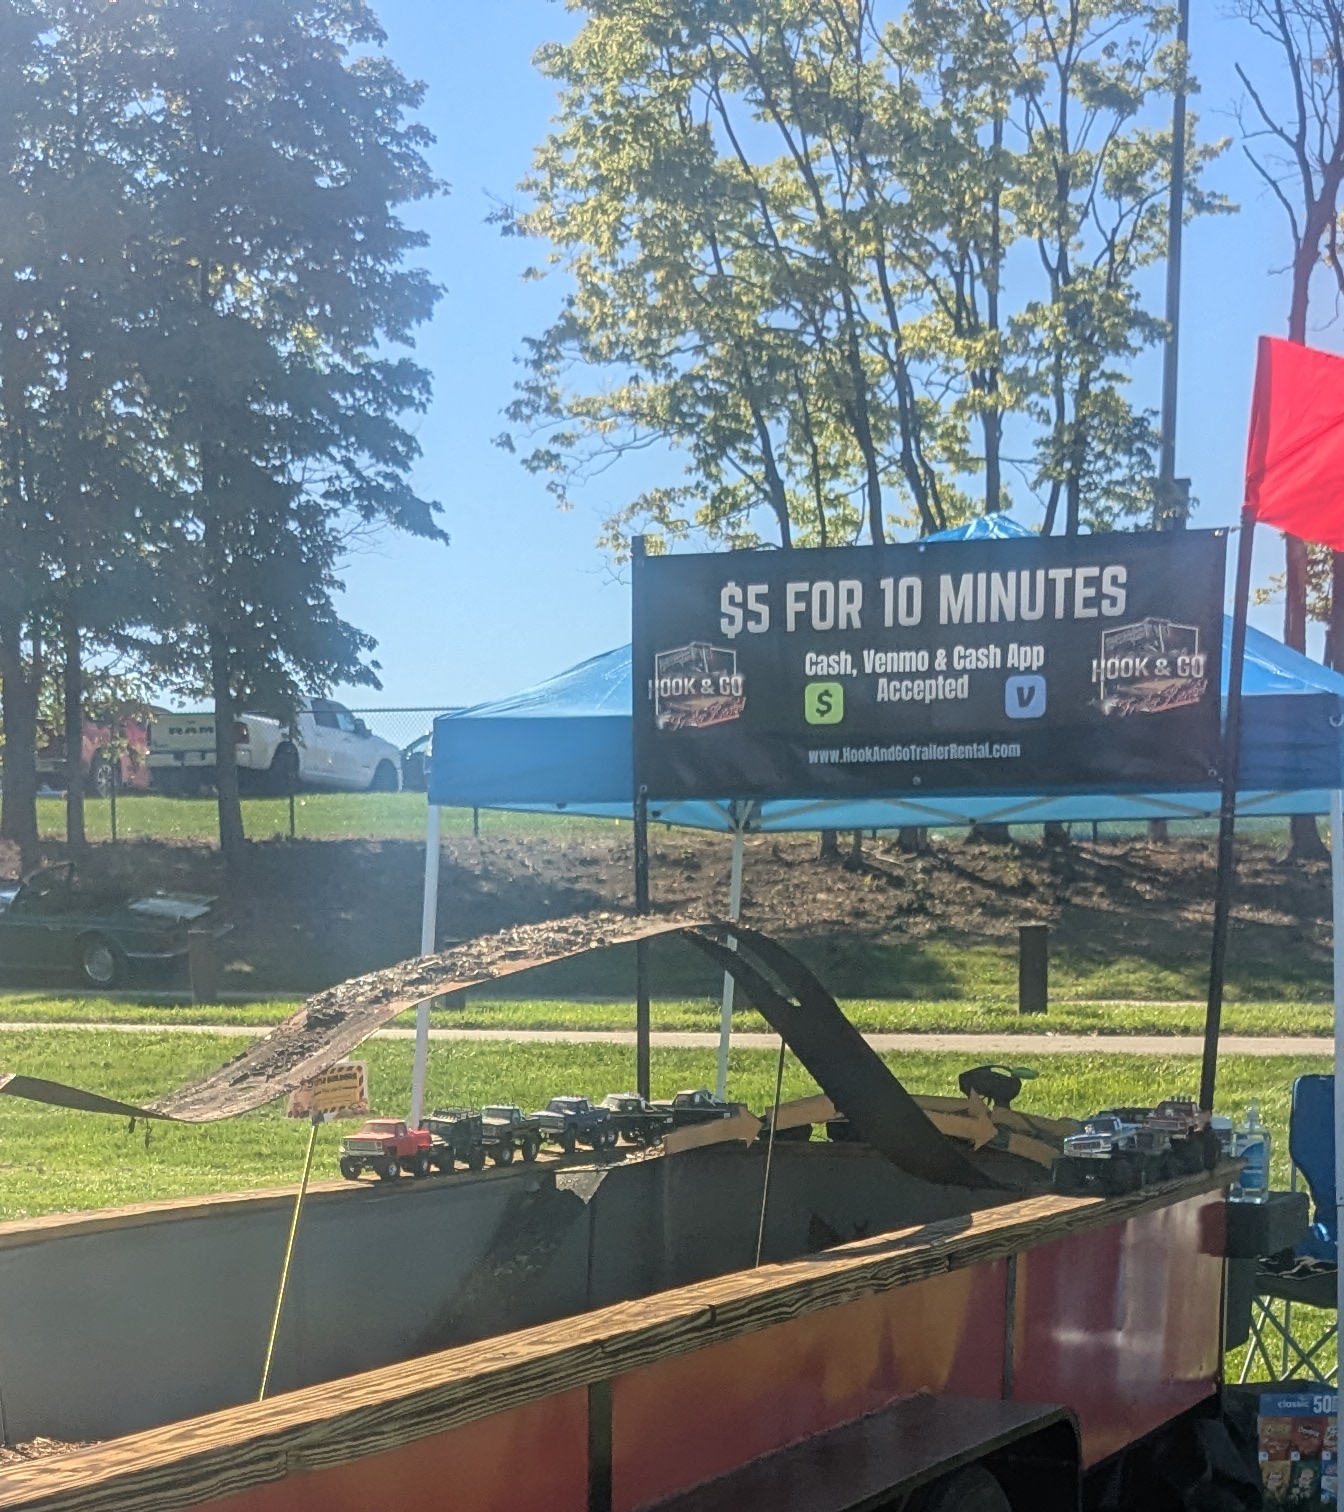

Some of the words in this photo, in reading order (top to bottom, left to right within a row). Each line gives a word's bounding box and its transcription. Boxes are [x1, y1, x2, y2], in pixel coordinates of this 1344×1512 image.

[720, 581, 770, 639] $5
[786, 579, 863, 632] FOR
[880, 576, 922, 628] 10
[939, 565, 1128, 625] MINUTES
[805, 650, 857, 678] Cash,
[862, 649, 929, 674] Venmo
[934, 649, 948, 671] &
[953, 644, 1001, 671] Cash
[1006, 642, 1045, 672] App
[1091, 656, 1149, 682] HOOK
[1154, 658, 1171, 676] &
[1176, 655, 1205, 678] GO
[648, 677, 696, 700] HOOK
[700, 678, 716, 695] &
[719, 675, 744, 697] GO
[876, 674, 969, 704] Accepted
[808, 741, 1021, 764] www.HookAndGoTrailerRental.com
